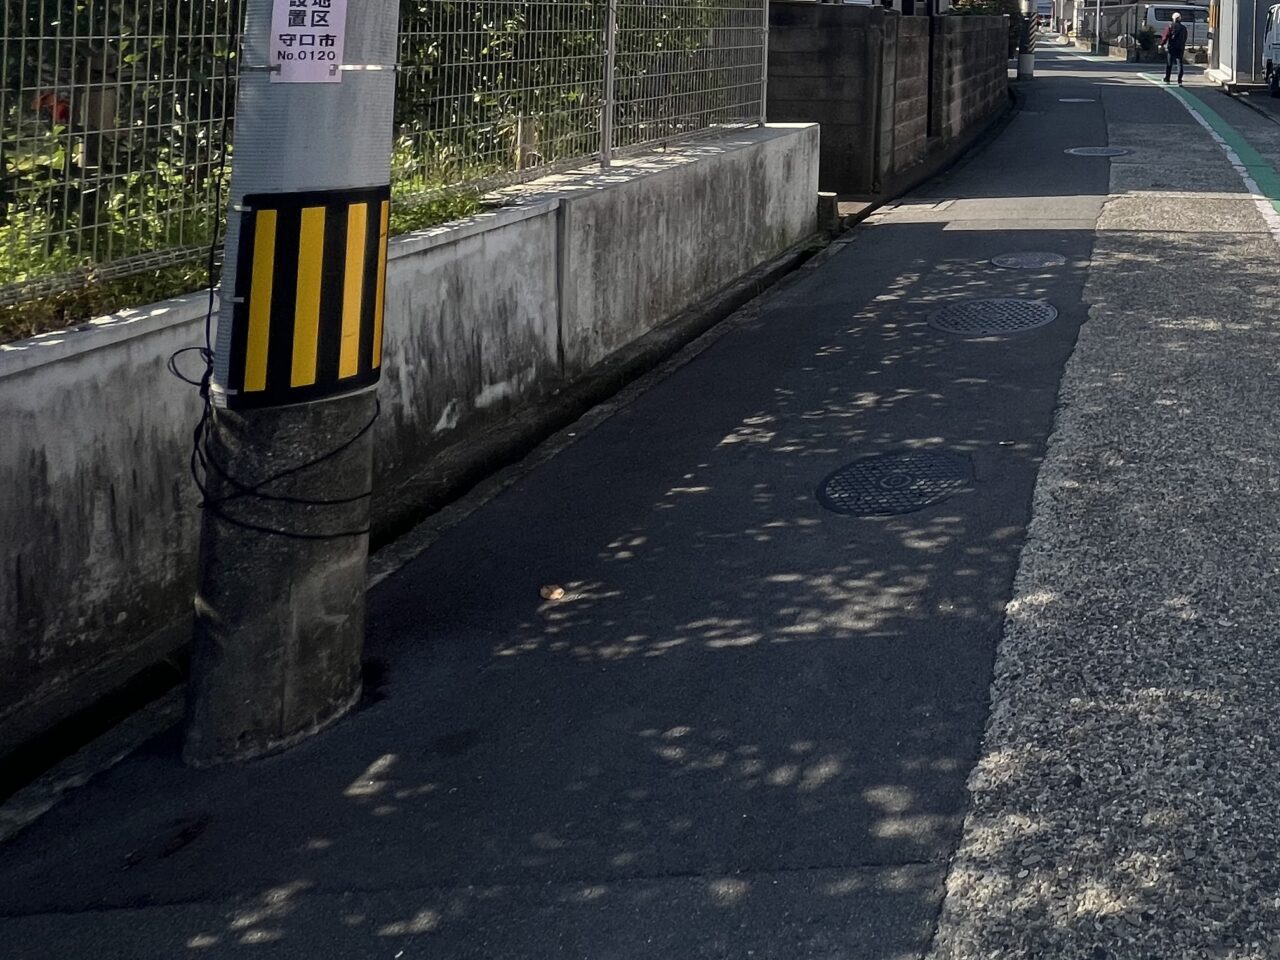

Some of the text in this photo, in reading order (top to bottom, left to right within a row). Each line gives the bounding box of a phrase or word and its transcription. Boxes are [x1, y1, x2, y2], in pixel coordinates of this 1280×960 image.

[279, 33, 337, 47] 守口市
[277, 50, 336, 61] No.0120
